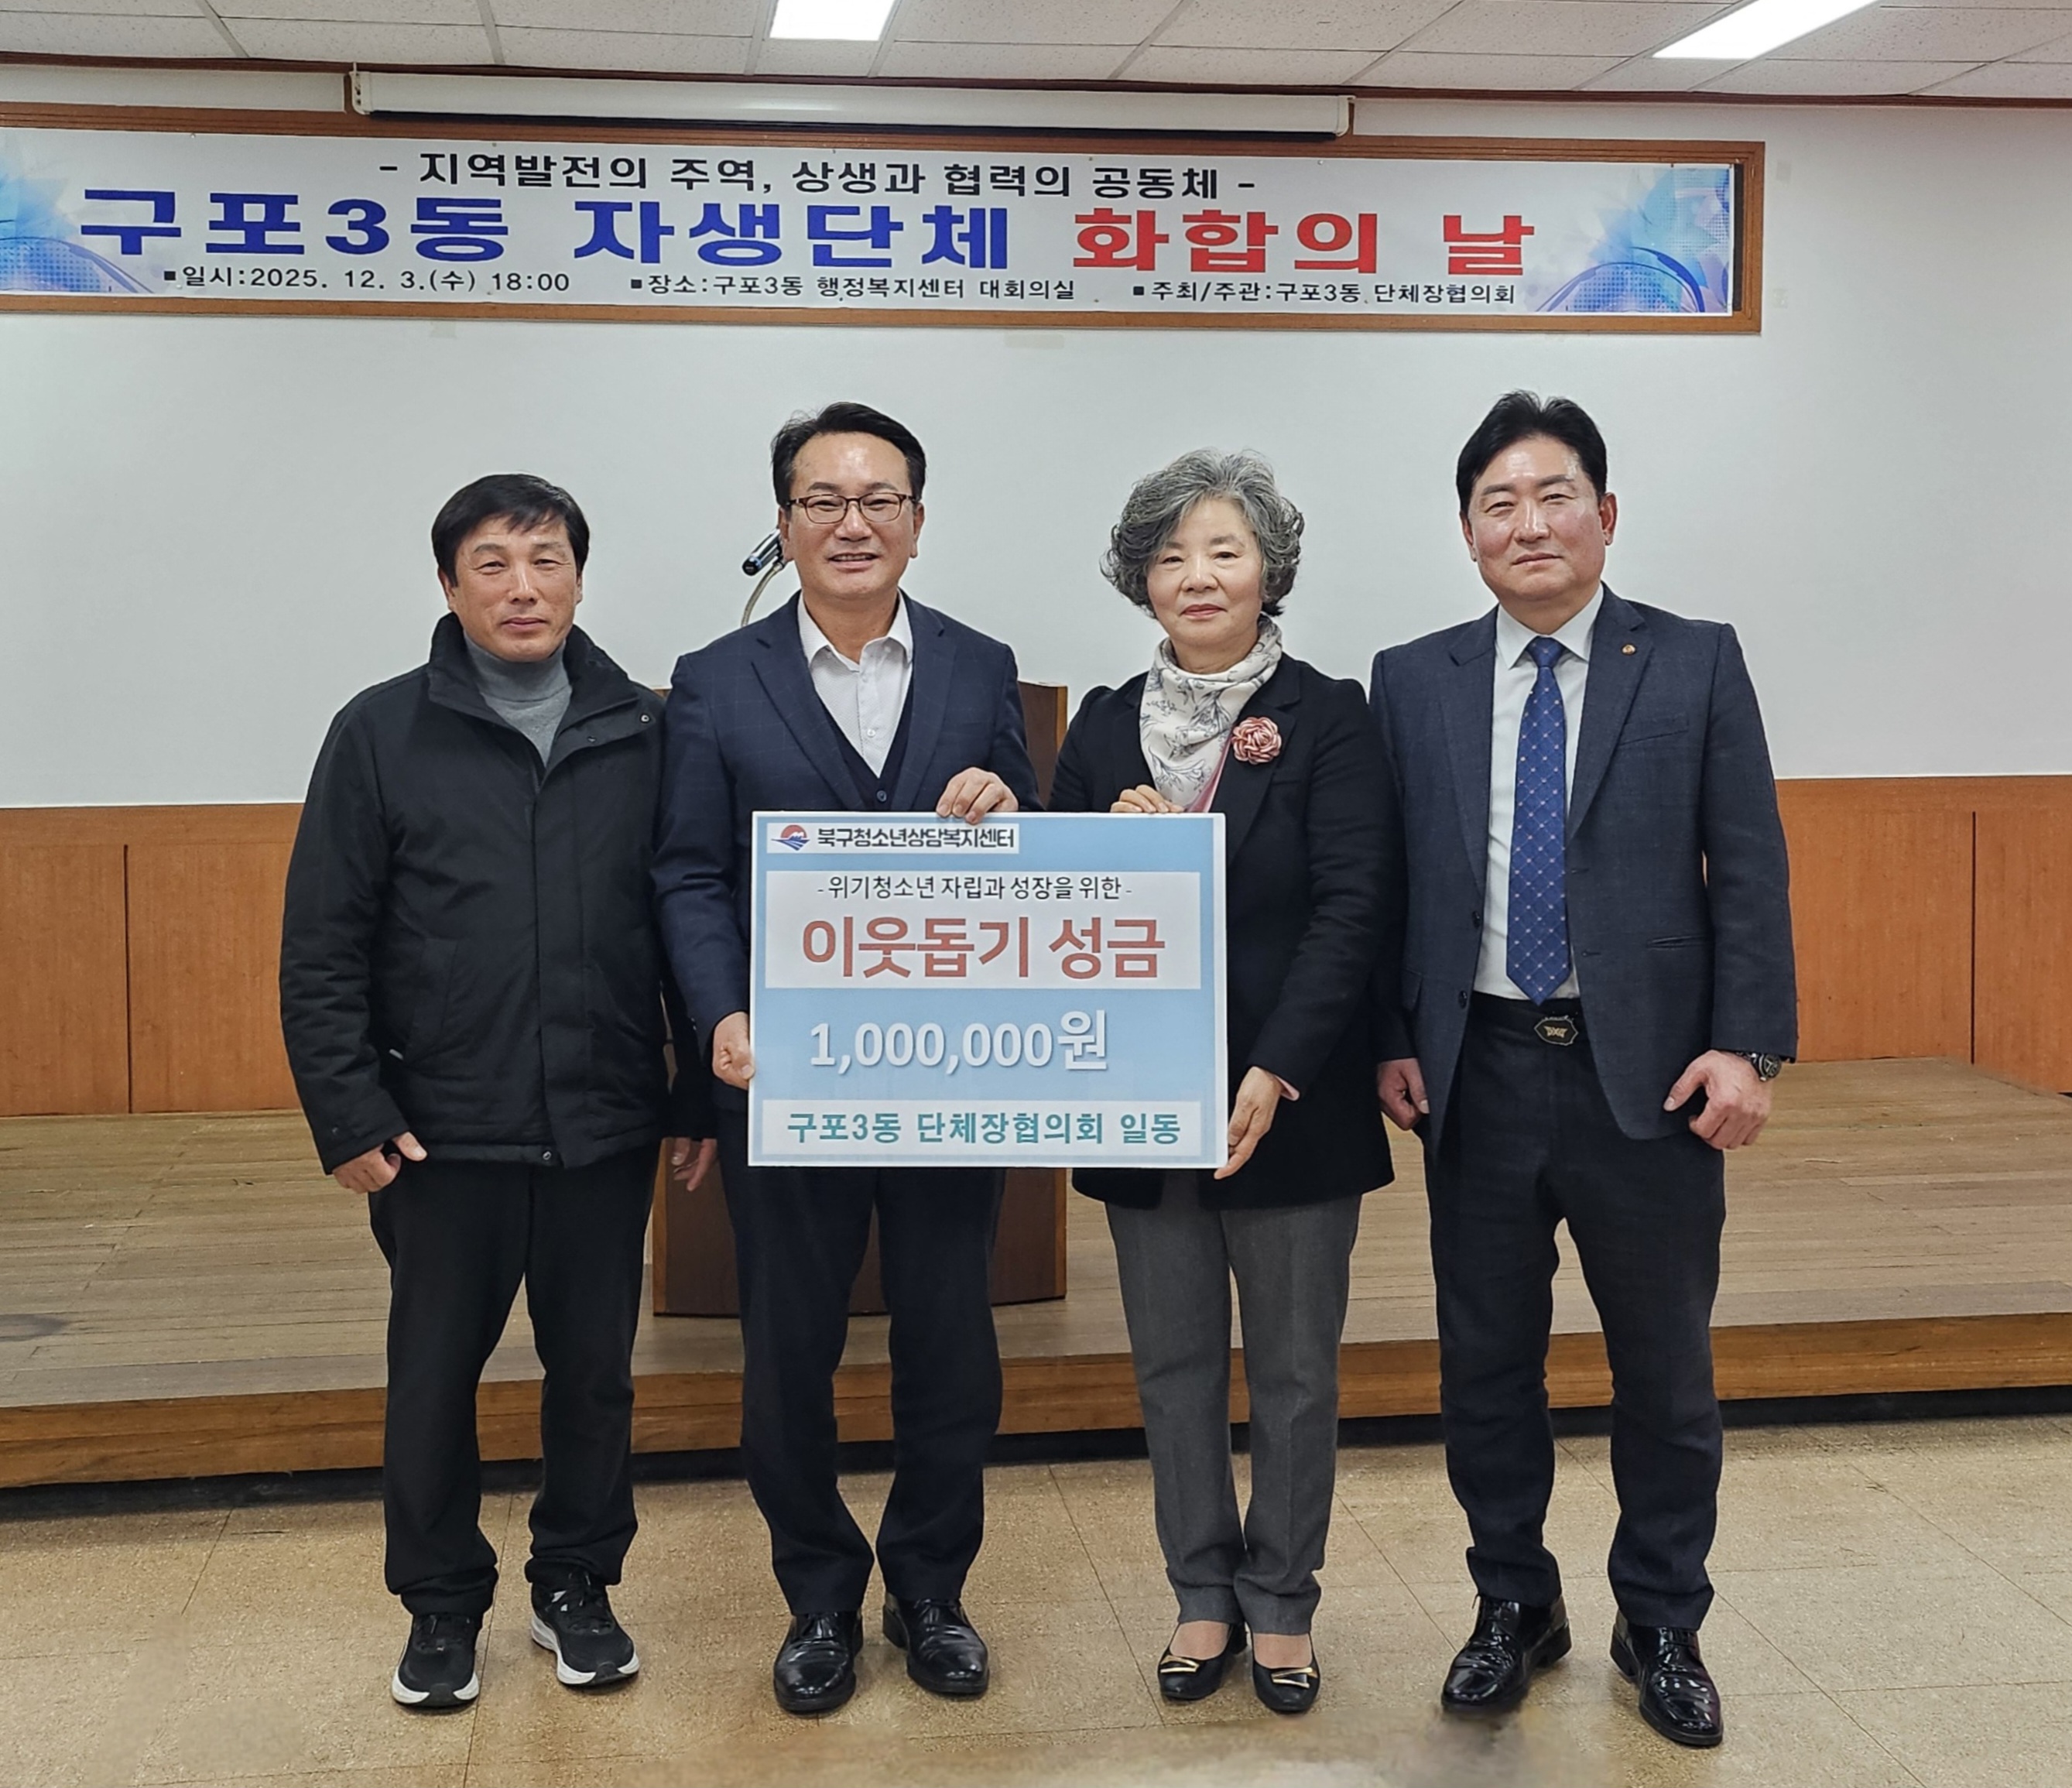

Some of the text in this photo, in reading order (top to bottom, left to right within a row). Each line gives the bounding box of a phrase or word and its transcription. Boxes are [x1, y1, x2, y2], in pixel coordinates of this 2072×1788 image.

[419, 152, 647, 190] 지역발전의
[670, 158, 772, 194] 주역,
[791, 160, 927, 195] 상생과
[943, 163, 1070, 198] 협력의
[1091, 166, 1218, 200] 공동체
[80, 189, 1536, 276] 구포3동 자생단체 화합의 날
[182, 265, 570, 293] 일시:2025. 12. 3.(수) 18:00
[647, 273, 1075, 300] 장소:구포3동 행정복지센터 대회의실
[1150, 281, 1515, 305] 주최/주관:구포3동 단체장협의회
[817, 827, 1015, 848] 북구청소년상담복지센터
[827, 875, 935, 900] 위기청소년
[940, 875, 1006, 900] 자립과
[1009, 875, 1074, 901] 성장을
[1078, 875, 1122, 900] 위한
[802, 916, 1166, 979] 이웃돕기 성금
[810, 1009, 1108, 1075] 1,000,000원
[787, 1112, 1181, 1145] 구포3동 단체장협의회 일동
